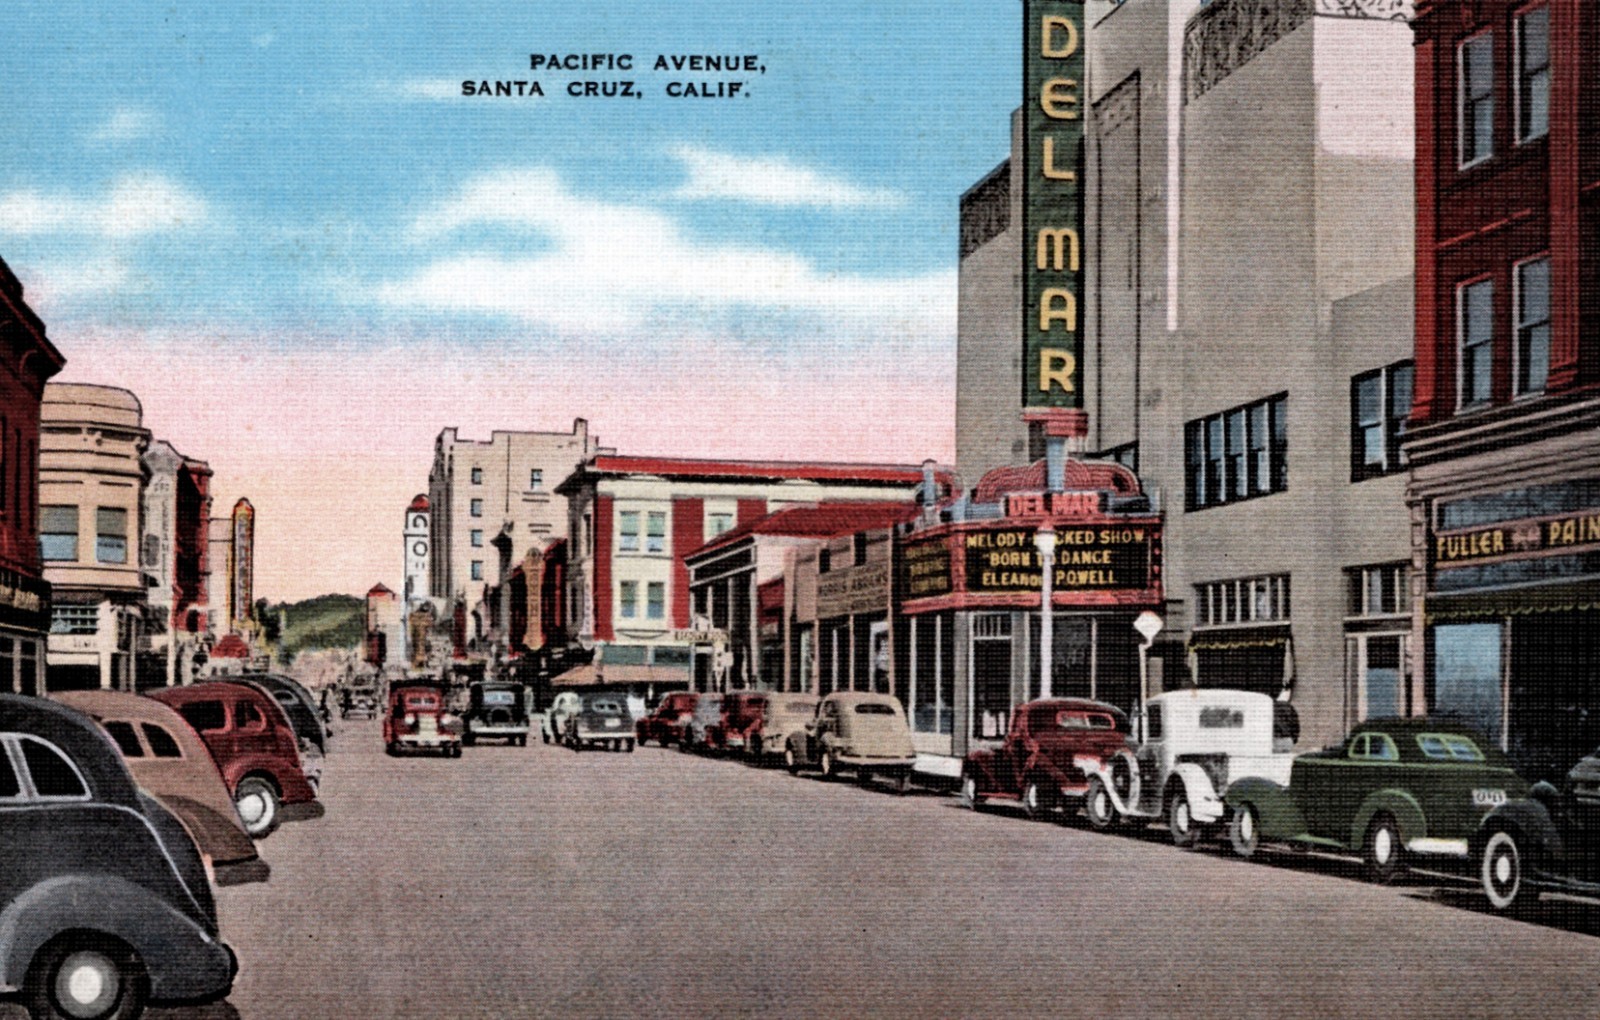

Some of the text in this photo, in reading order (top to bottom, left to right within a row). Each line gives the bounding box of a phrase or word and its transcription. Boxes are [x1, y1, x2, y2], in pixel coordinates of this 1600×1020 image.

[1036, 15, 1080, 393] DEL MAR
[1008, 491, 1099, 516] DEL MAR
[966, 532, 1027, 548] MELODY
[1100, 528, 1145, 544] SHOW
[1435, 514, 1600, 560] FULLER PAIN
[1056, 569, 1118, 585] POWELL
